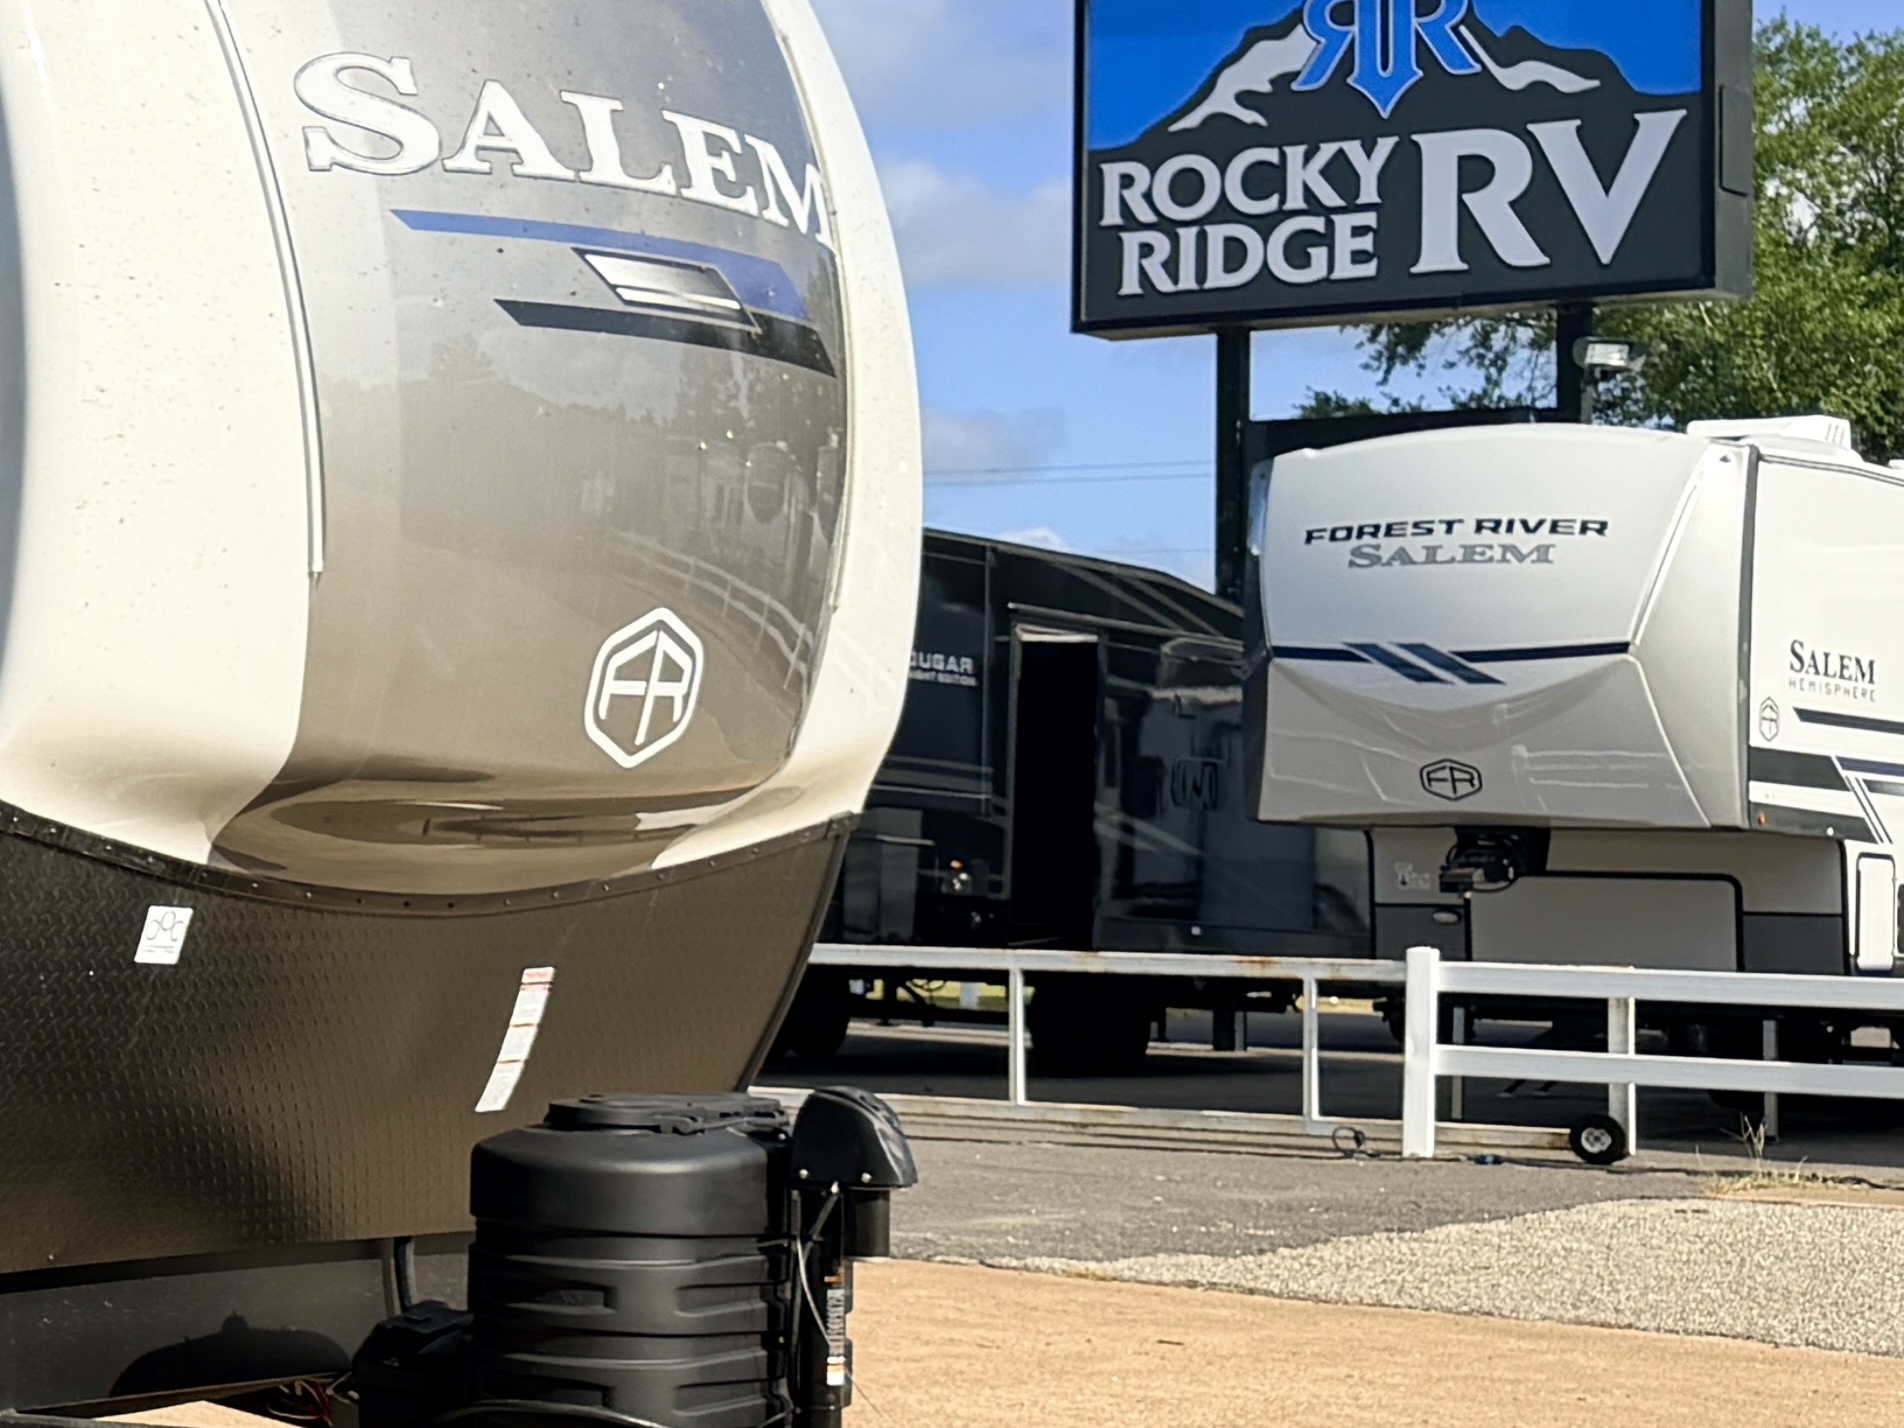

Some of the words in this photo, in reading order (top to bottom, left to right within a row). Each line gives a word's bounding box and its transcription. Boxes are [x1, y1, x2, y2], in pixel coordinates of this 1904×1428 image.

[293, 51, 839, 260] SALEM
[1097, 134, 1400, 228] ROCKY
[1408, 108, 1688, 276] RV
[1117, 211, 1380, 297] RIDGE
[1304, 518, 1464, 545] FOREST
[1474, 517, 1609, 537] RIVER
[1347, 543, 1556, 569] SALEM
[910, 650, 974, 675] UGAR
[1789, 639, 1876, 685] SALEM
